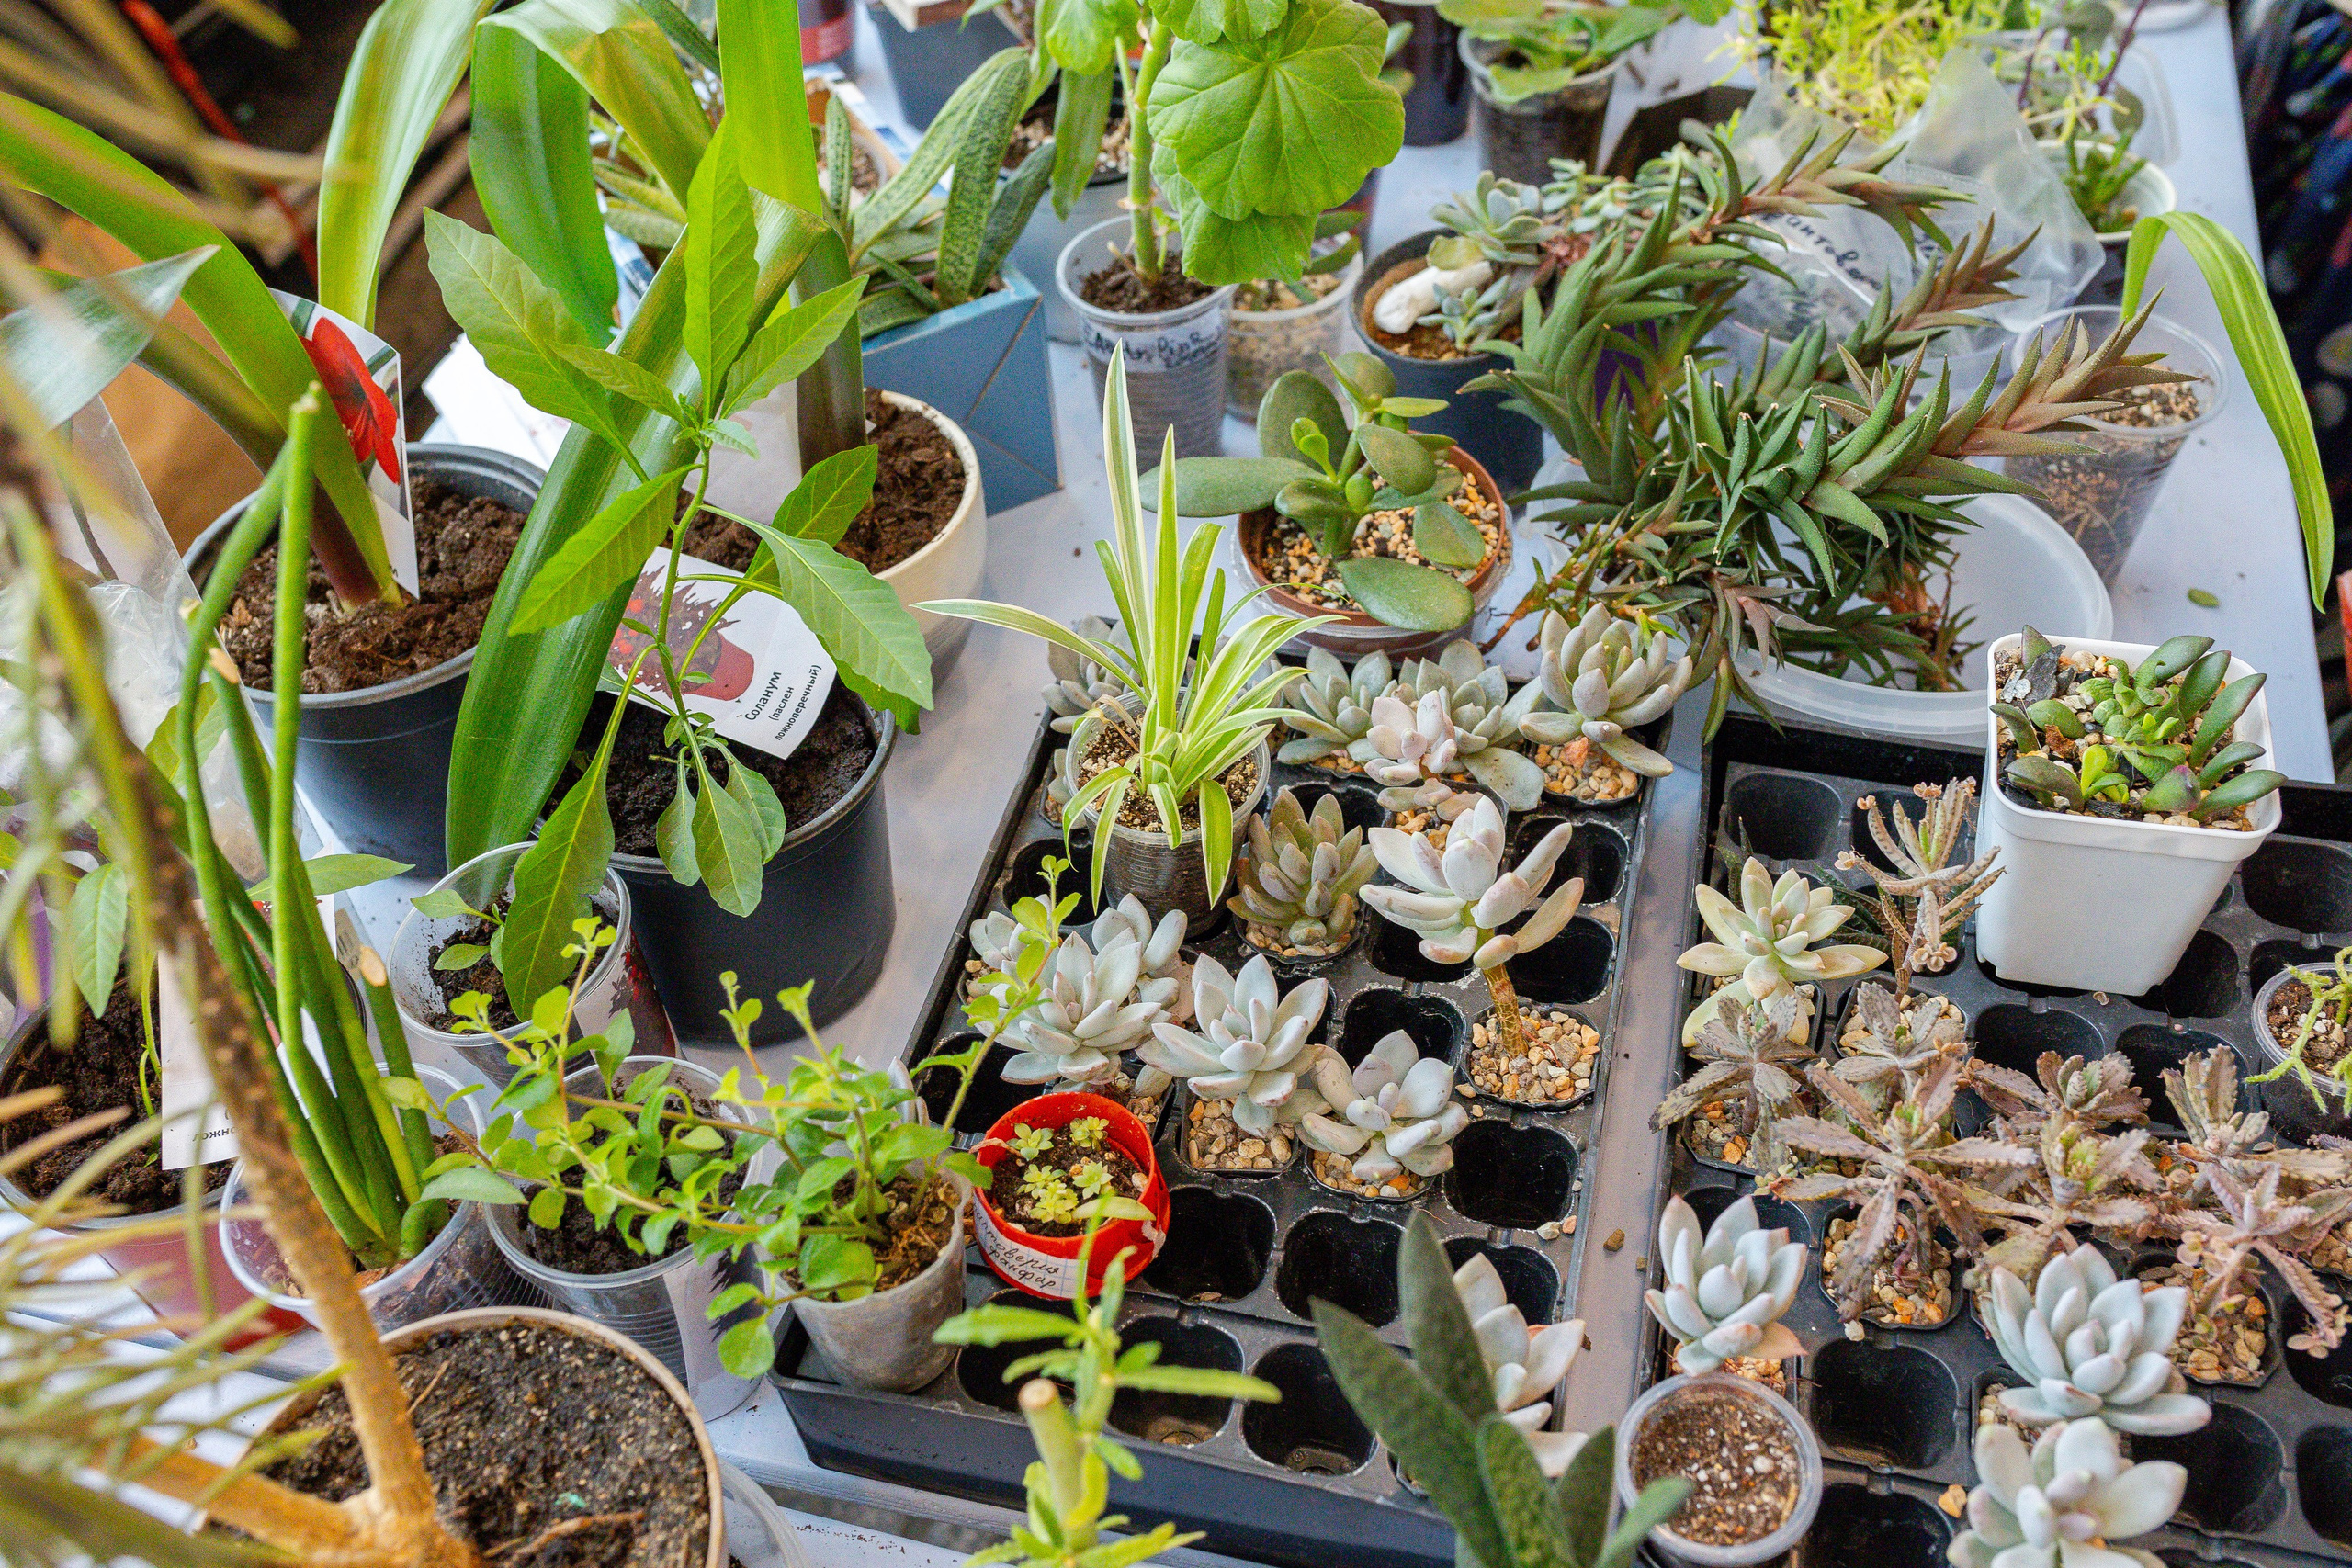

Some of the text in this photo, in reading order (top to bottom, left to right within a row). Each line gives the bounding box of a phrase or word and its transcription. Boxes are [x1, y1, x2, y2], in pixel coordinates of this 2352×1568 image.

[744, 671, 782, 721] Соланум
[768, 686, 795, 721] (паслен
[775, 664, 822, 741] ложноперечный)
